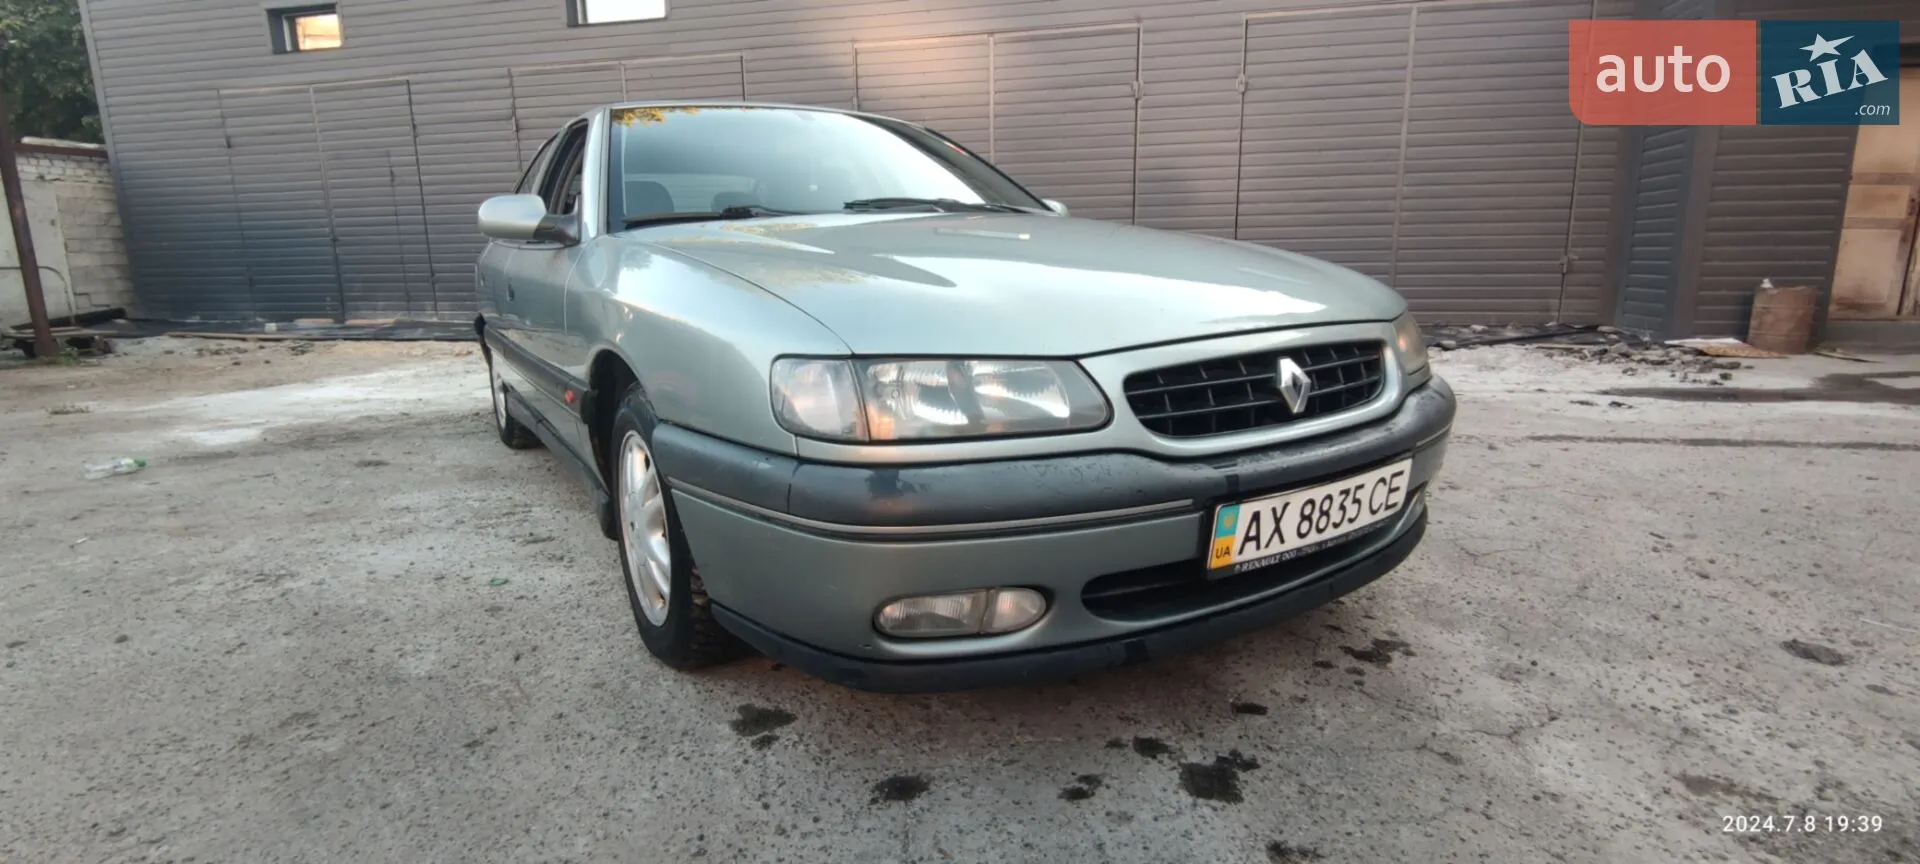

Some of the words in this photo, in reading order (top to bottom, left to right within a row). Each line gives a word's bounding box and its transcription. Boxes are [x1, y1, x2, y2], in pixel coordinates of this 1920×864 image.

[1237, 501, 1292, 556] AX
[1296, 483, 1365, 539] 8835
[1368, 470, 1405, 516] CE
[1215, 545, 1231, 559] UA
[1241, 554, 1281, 572] RENAULT
